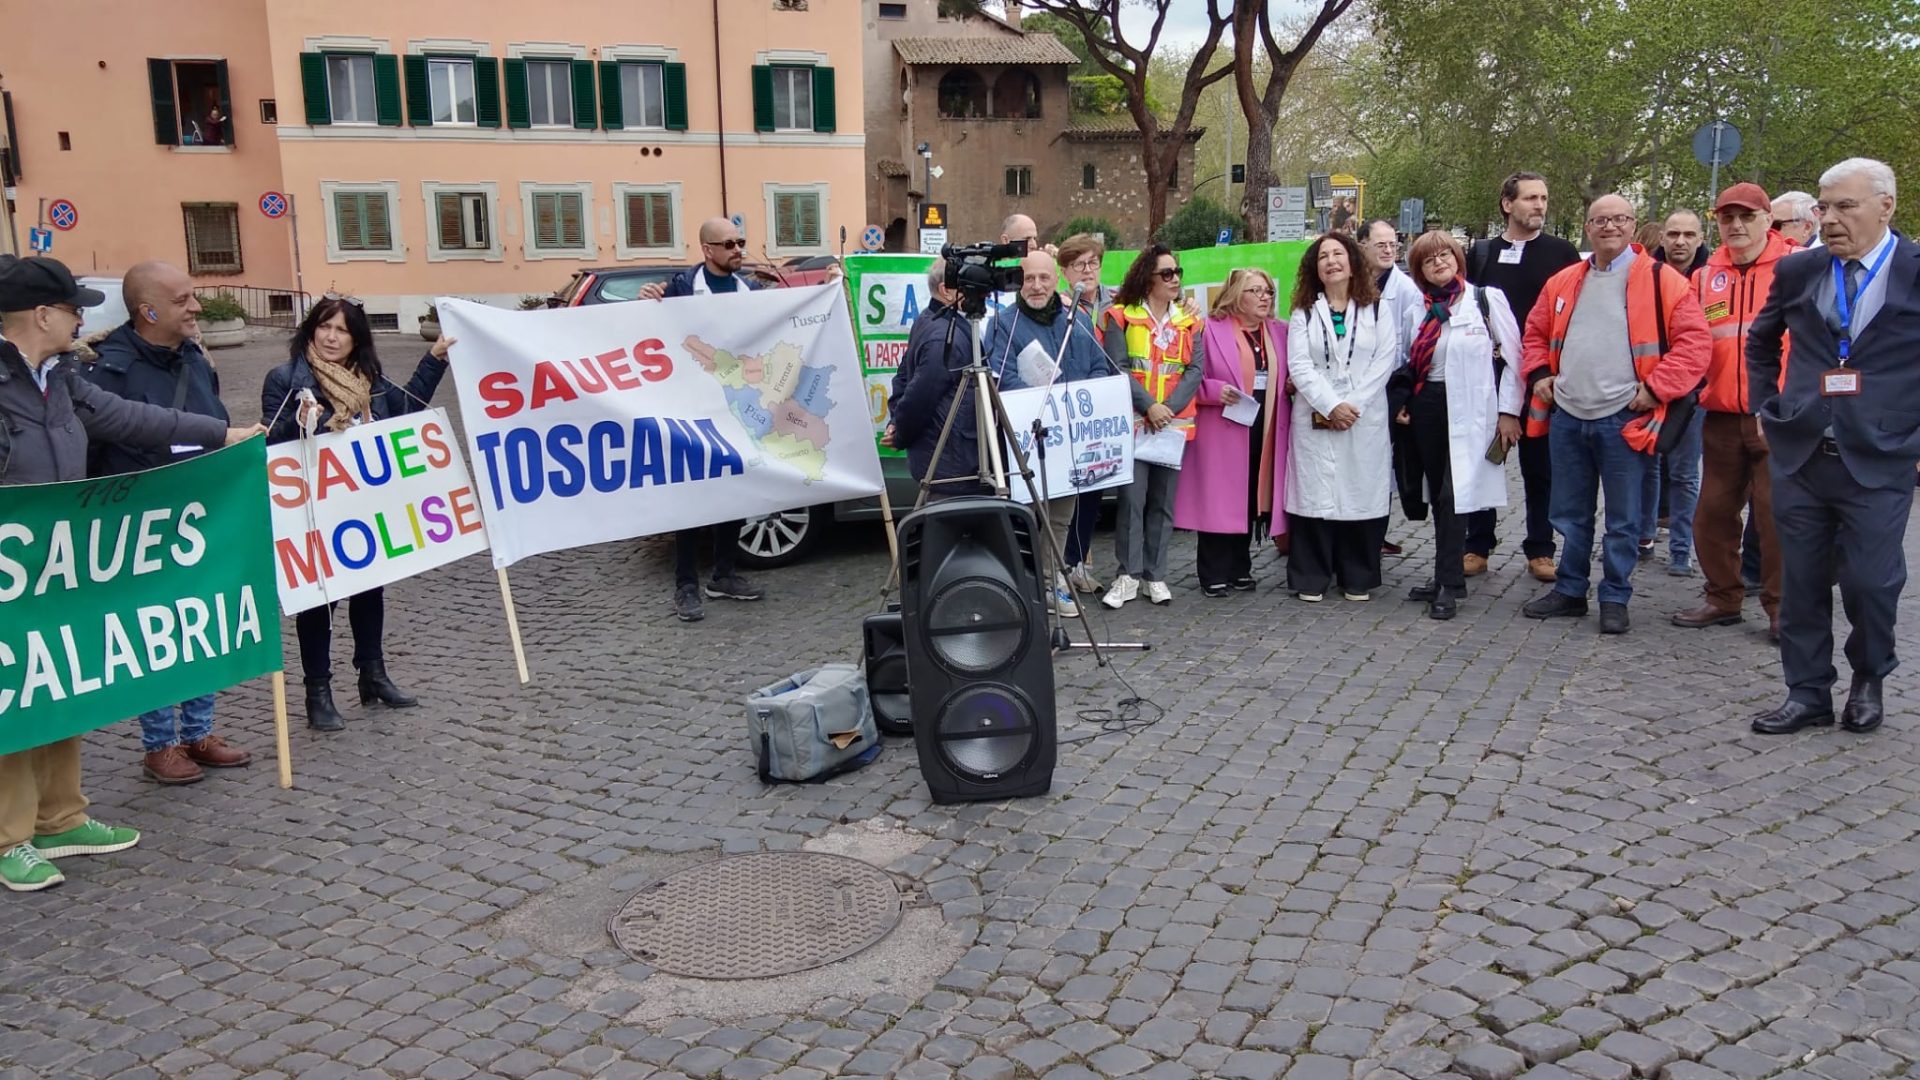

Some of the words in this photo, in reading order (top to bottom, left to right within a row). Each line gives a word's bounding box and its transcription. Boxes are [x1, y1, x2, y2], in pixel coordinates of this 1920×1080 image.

[478, 337, 674, 419] SAUES
[773, 361, 794, 393] Firenze
[804, 374, 821, 406] Arezzo
[744, 404, 766, 425] Pisa
[785, 411, 808, 429] Siena
[1045, 389, 1093, 422] 118
[1014, 425, 1064, 451] SAES
[1071, 415, 1130, 443] UMBRIA
[267, 422, 451, 508] SAUES
[476, 416, 744, 511] TOSCANA
[77, 474, 138, 508] 118
[0, 502, 207, 603] SAUES
[275, 486, 483, 590] MOLISE
